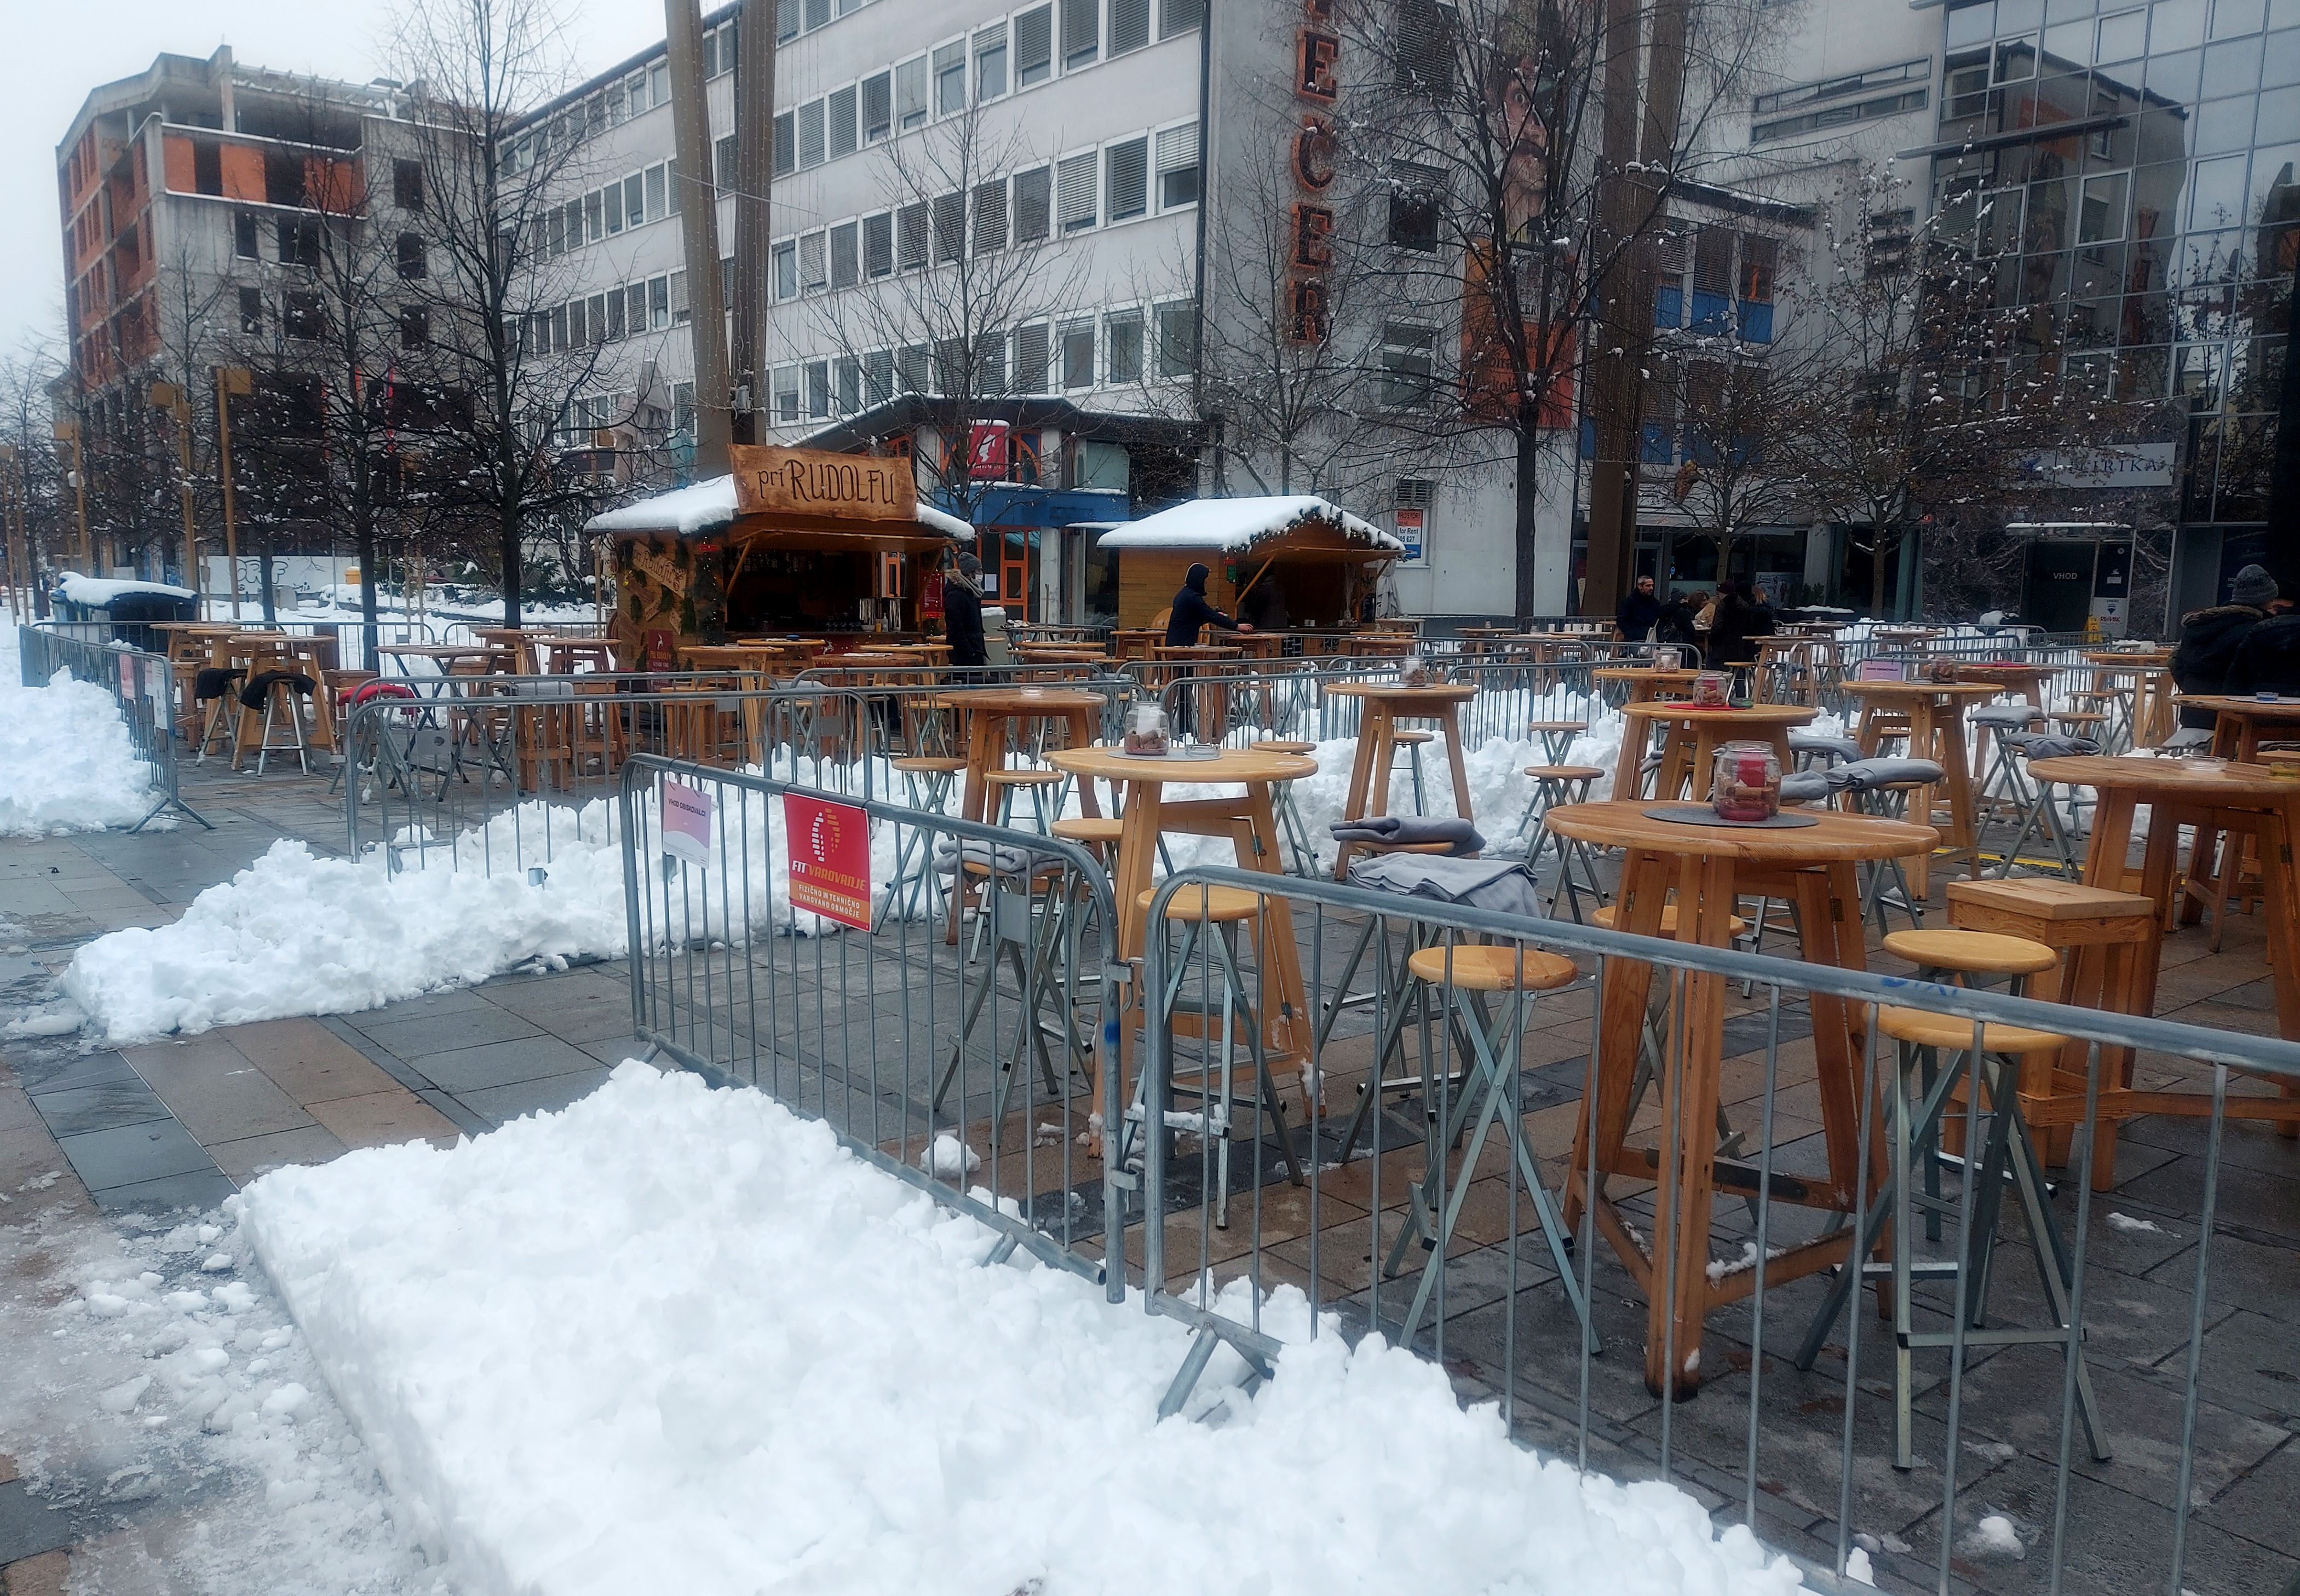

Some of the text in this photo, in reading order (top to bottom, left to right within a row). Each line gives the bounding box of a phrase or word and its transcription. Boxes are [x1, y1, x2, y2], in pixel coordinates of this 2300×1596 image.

[1288, 0, 1340, 345] EČER
[757, 458, 897, 505] pri RUDOLFU
[668, 798, 706, 817] VHOD OBISKOVALCI
[807, 864, 866, 891] VAROVANJE
[798, 884, 860, 909] FIZIČNO IN TEHNIČNO
[799, 892, 860, 918] VAROVANO OBMOČJE
